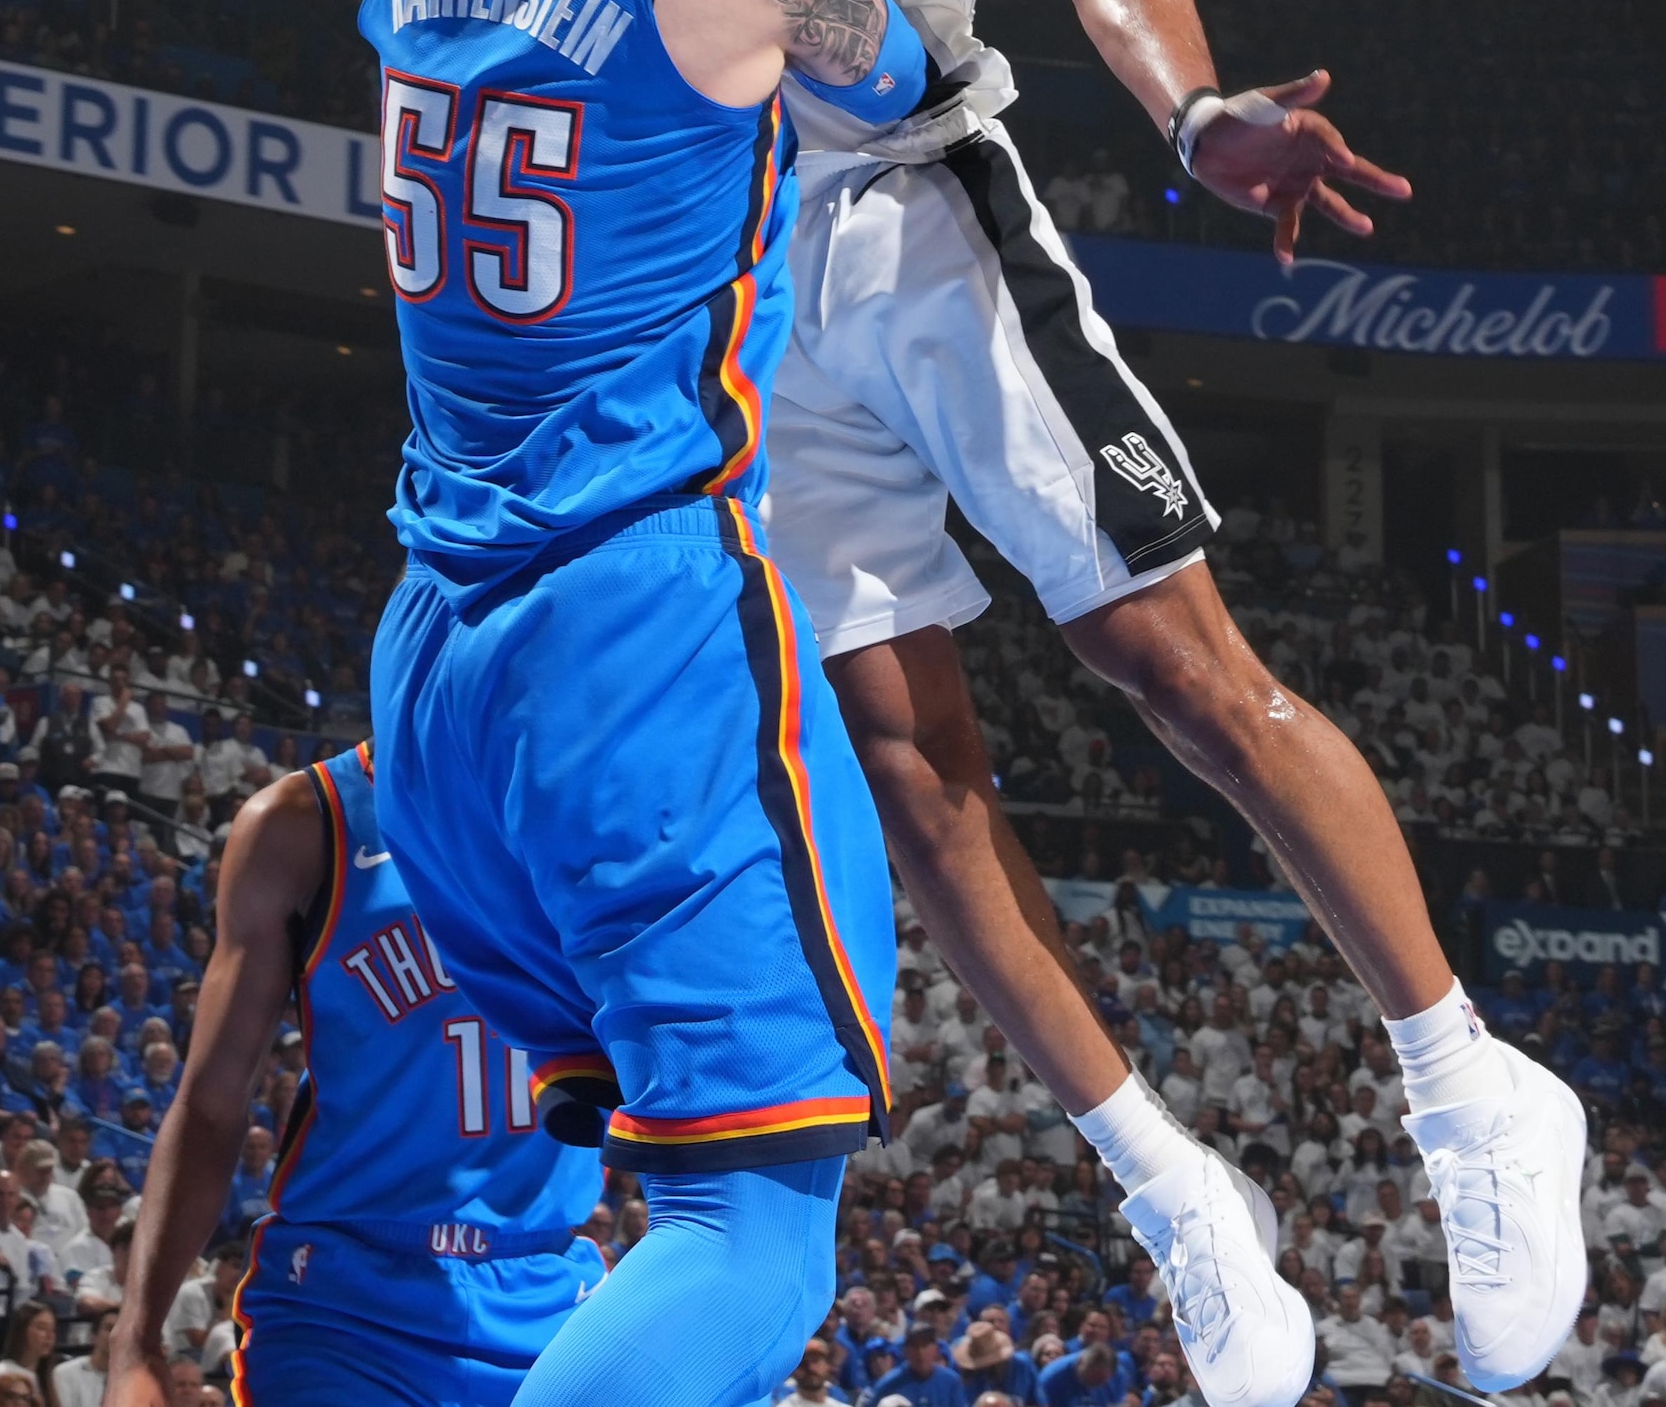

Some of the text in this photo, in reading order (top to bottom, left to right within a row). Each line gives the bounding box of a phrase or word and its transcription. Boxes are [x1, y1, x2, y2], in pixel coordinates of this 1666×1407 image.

[381, 66, 585, 326] 55
[1251, 257, 1617, 359] Michelob
[1189, 895, 1311, 921] EXPANDIN
[1492, 917, 1662, 968] expand
[431, 1223, 489, 1255] OKC
